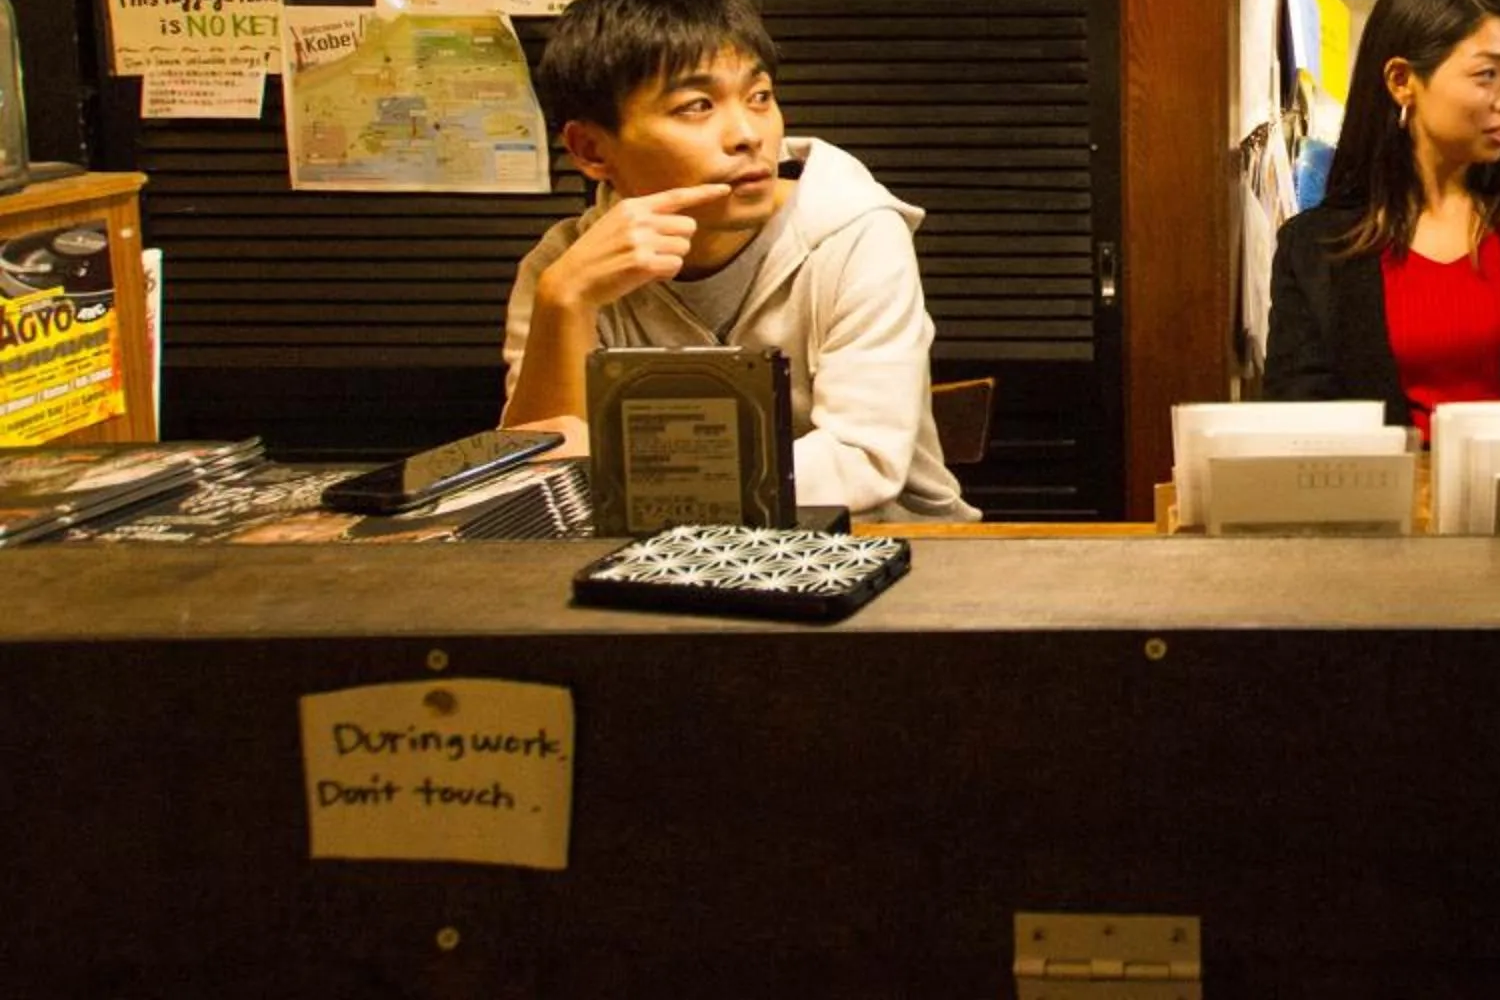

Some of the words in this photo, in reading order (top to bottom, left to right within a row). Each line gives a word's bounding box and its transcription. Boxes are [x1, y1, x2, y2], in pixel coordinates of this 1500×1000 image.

[160, 18, 182, 35] is
[186, 14, 225, 37] NO
[333, 722, 465, 761] During
